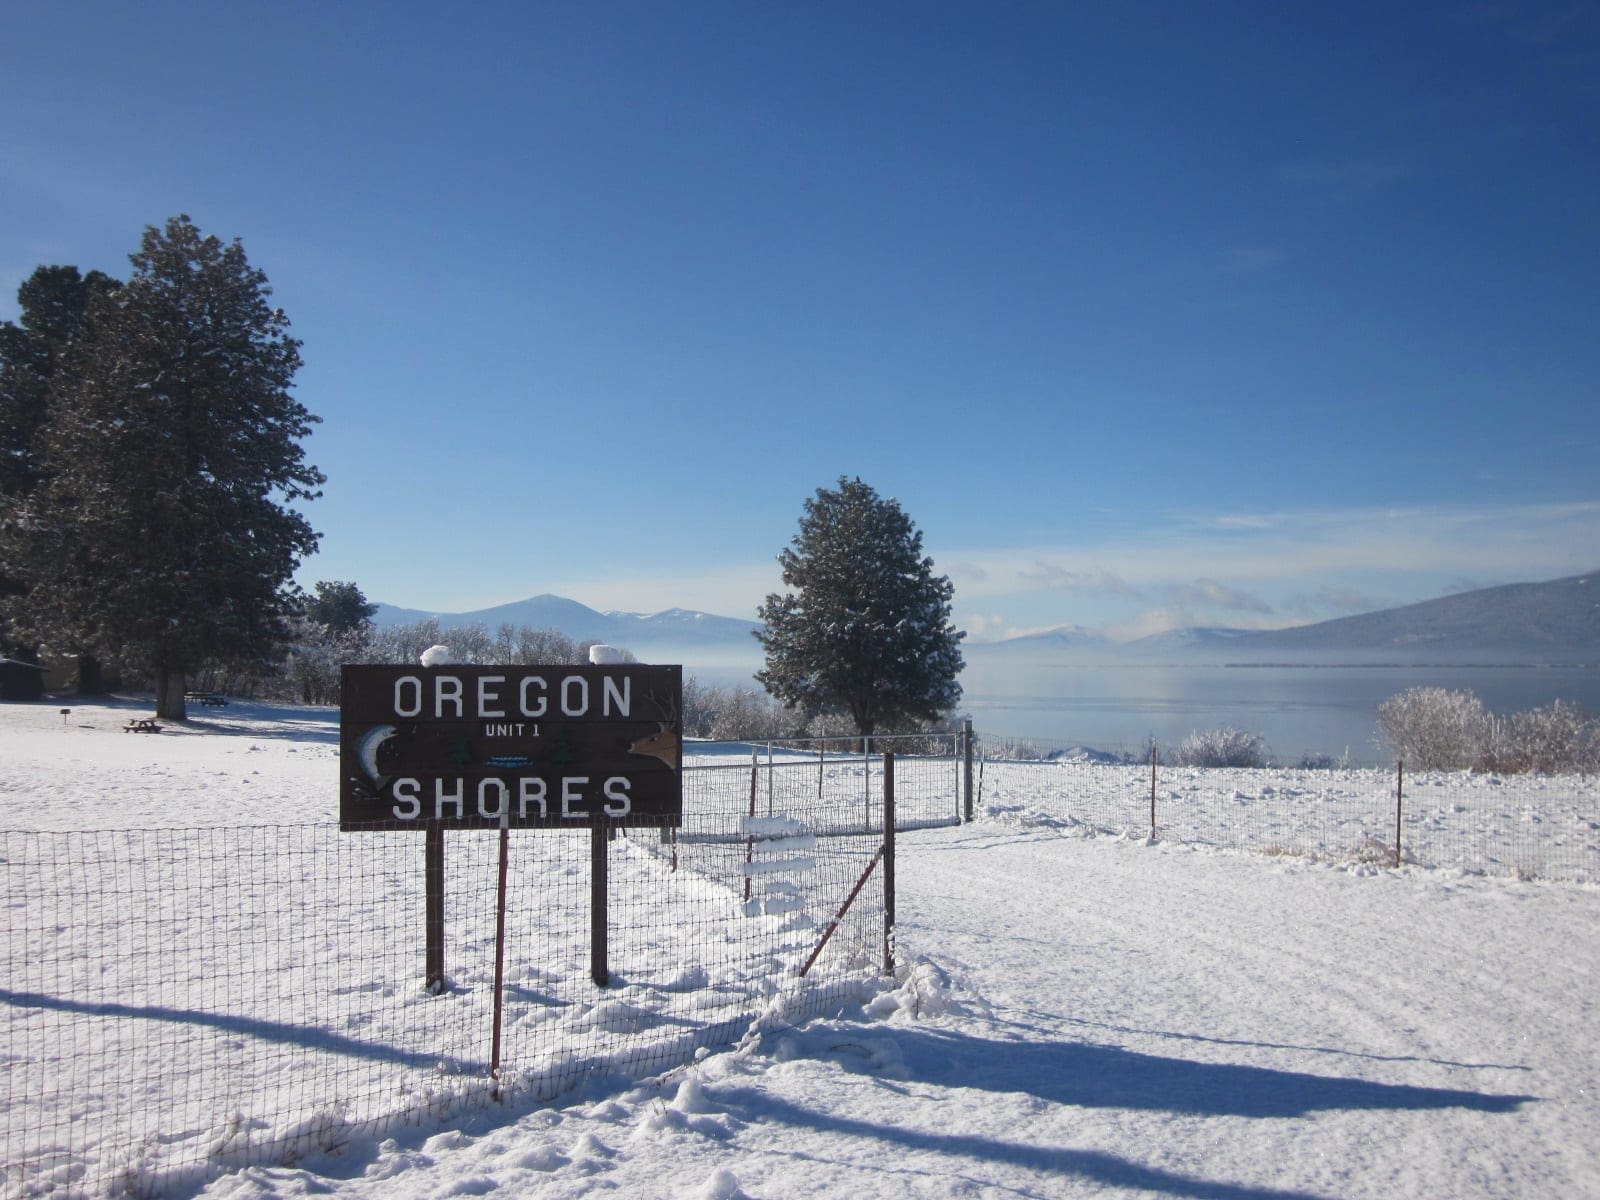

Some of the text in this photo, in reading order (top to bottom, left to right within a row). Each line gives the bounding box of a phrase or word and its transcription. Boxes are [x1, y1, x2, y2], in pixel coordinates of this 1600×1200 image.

[394, 675, 631, 718] OREGON
[485, 723, 540, 737] UNIT 1
[392, 776, 632, 820] SHORES
